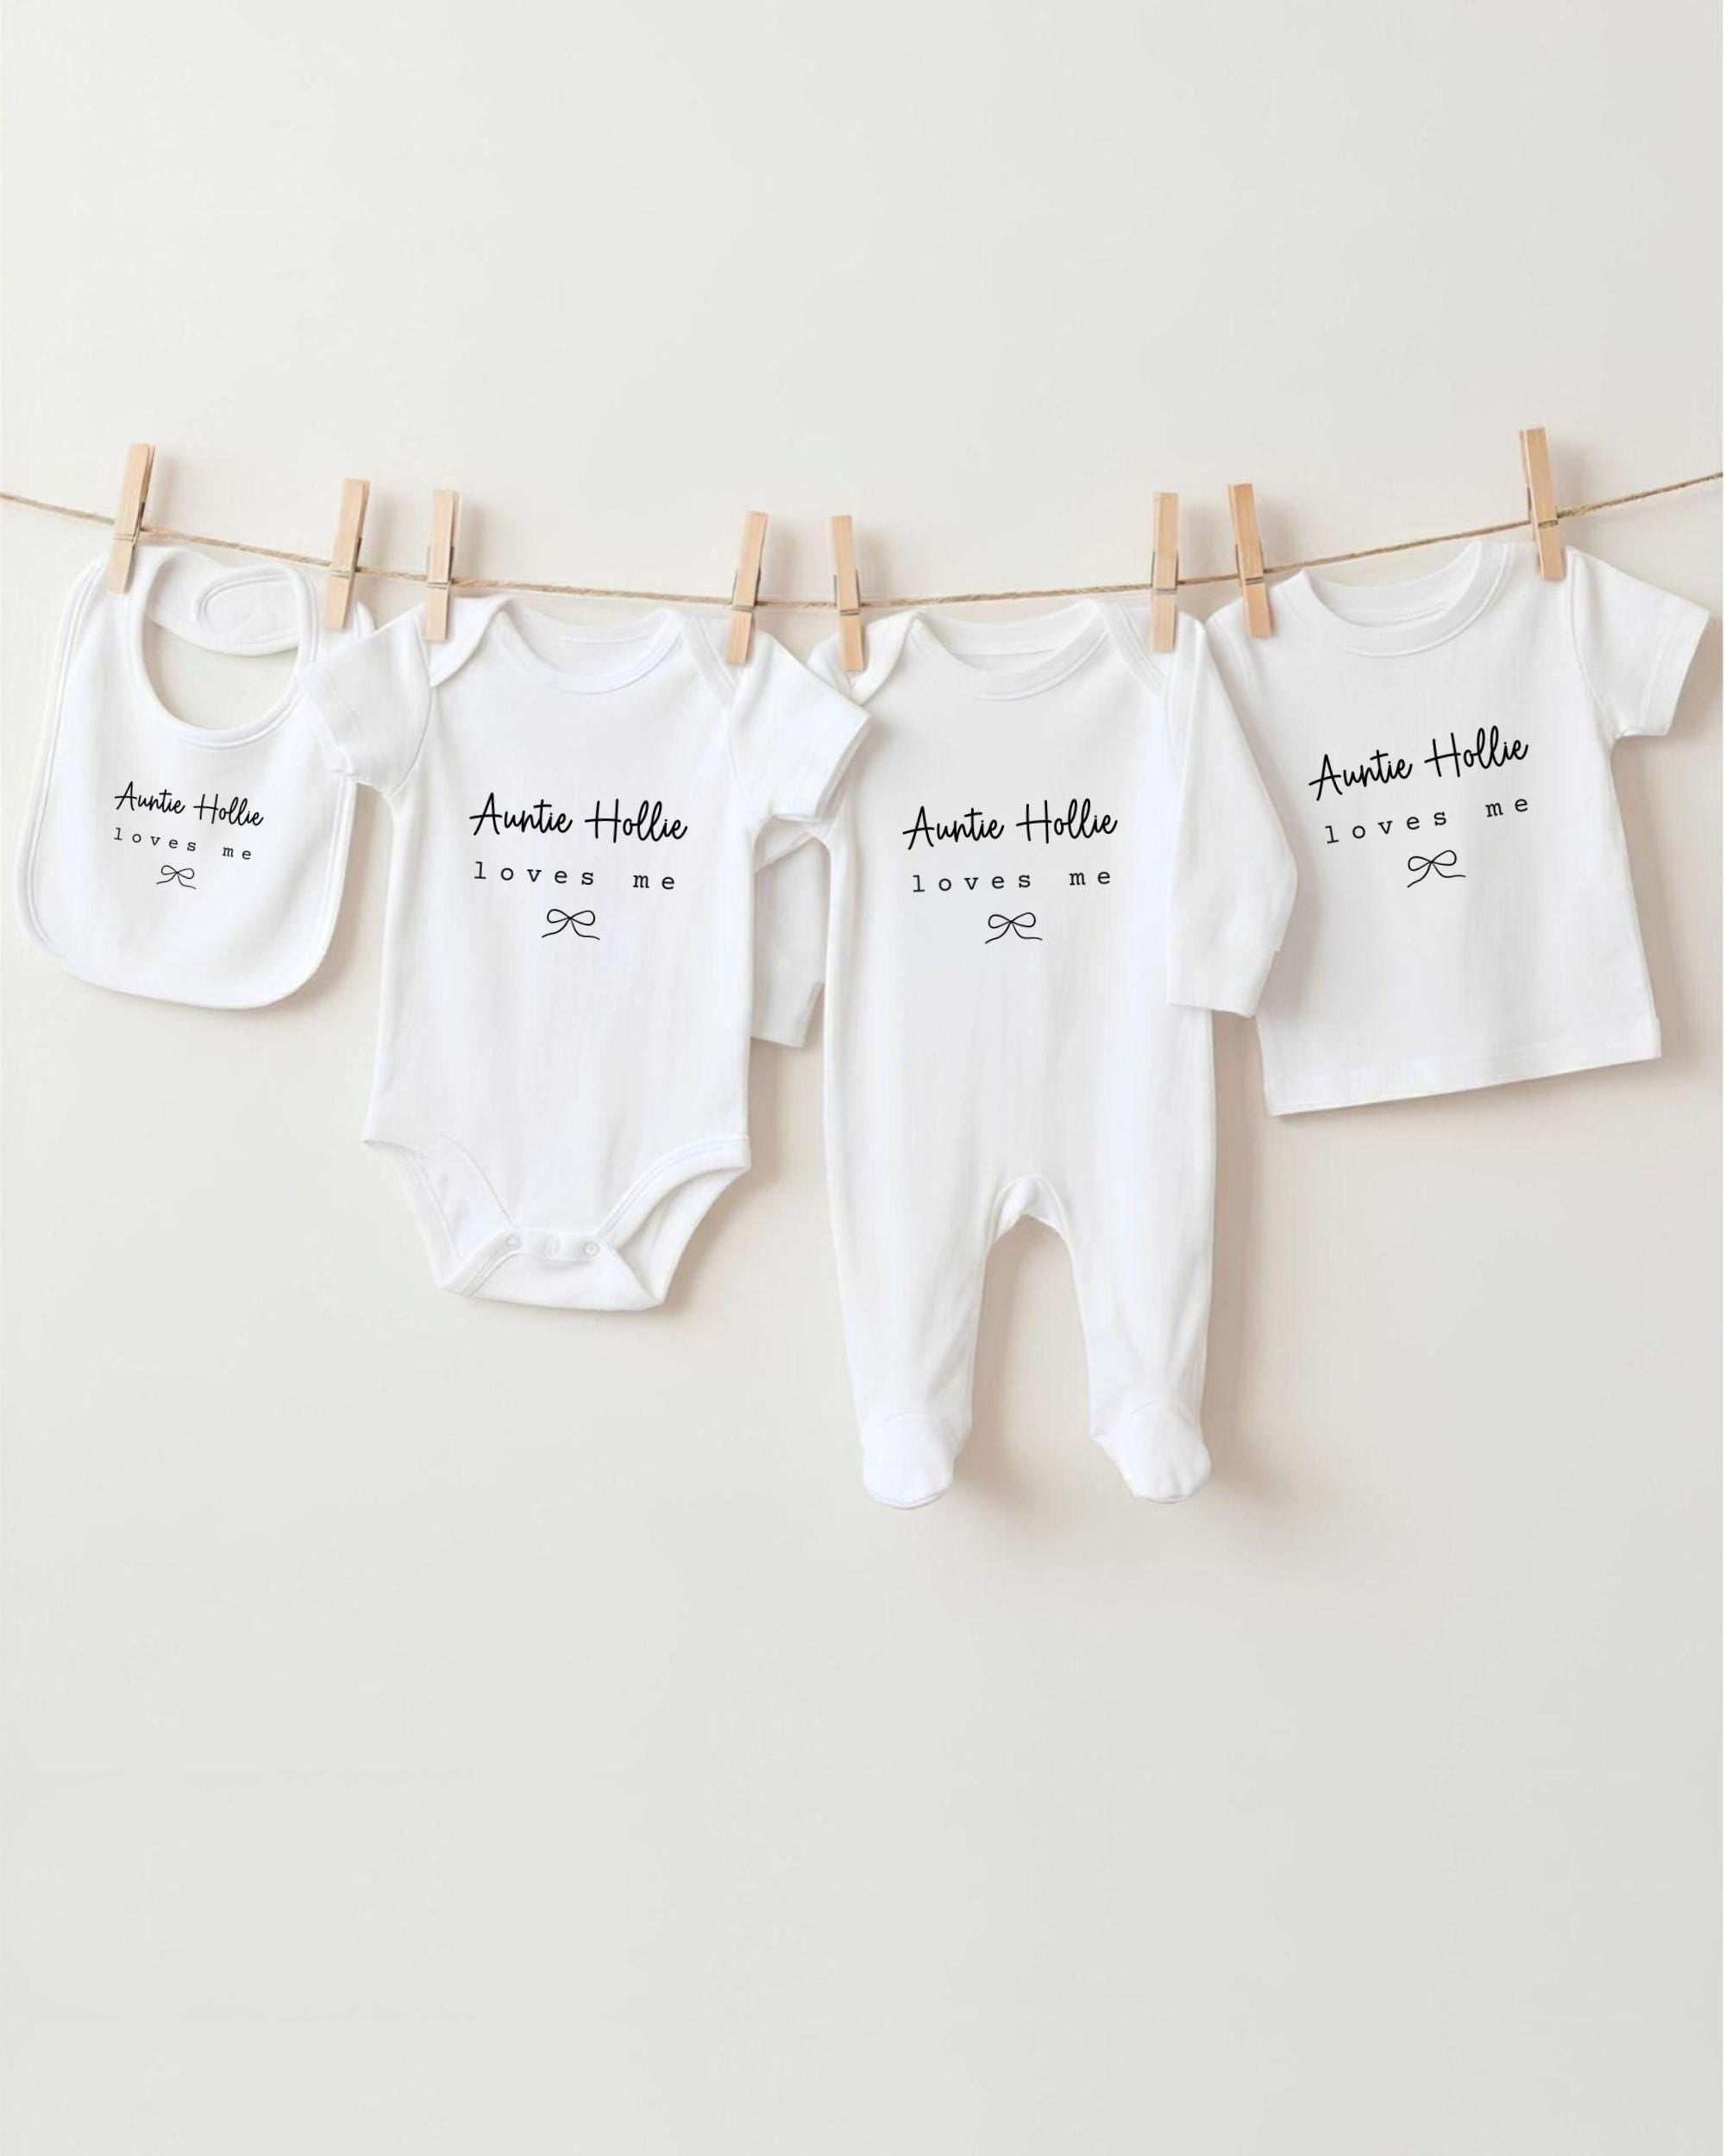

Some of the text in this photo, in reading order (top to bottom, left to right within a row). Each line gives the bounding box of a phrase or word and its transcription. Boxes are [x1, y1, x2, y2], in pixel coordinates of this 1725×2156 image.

[1308, 724, 1529, 802] Auntie Hollie
[114, 780, 265, 827] Auntie Hollie
[468, 792, 688, 844] Auntie Hollie
[901, 798, 1119, 851] Auntie Hollie
[1324, 798, 1528, 844] loves me
[113, 827, 252, 861] loves me
[474, 861, 675, 890] loves me
[913, 871, 1111, 893] loves me
